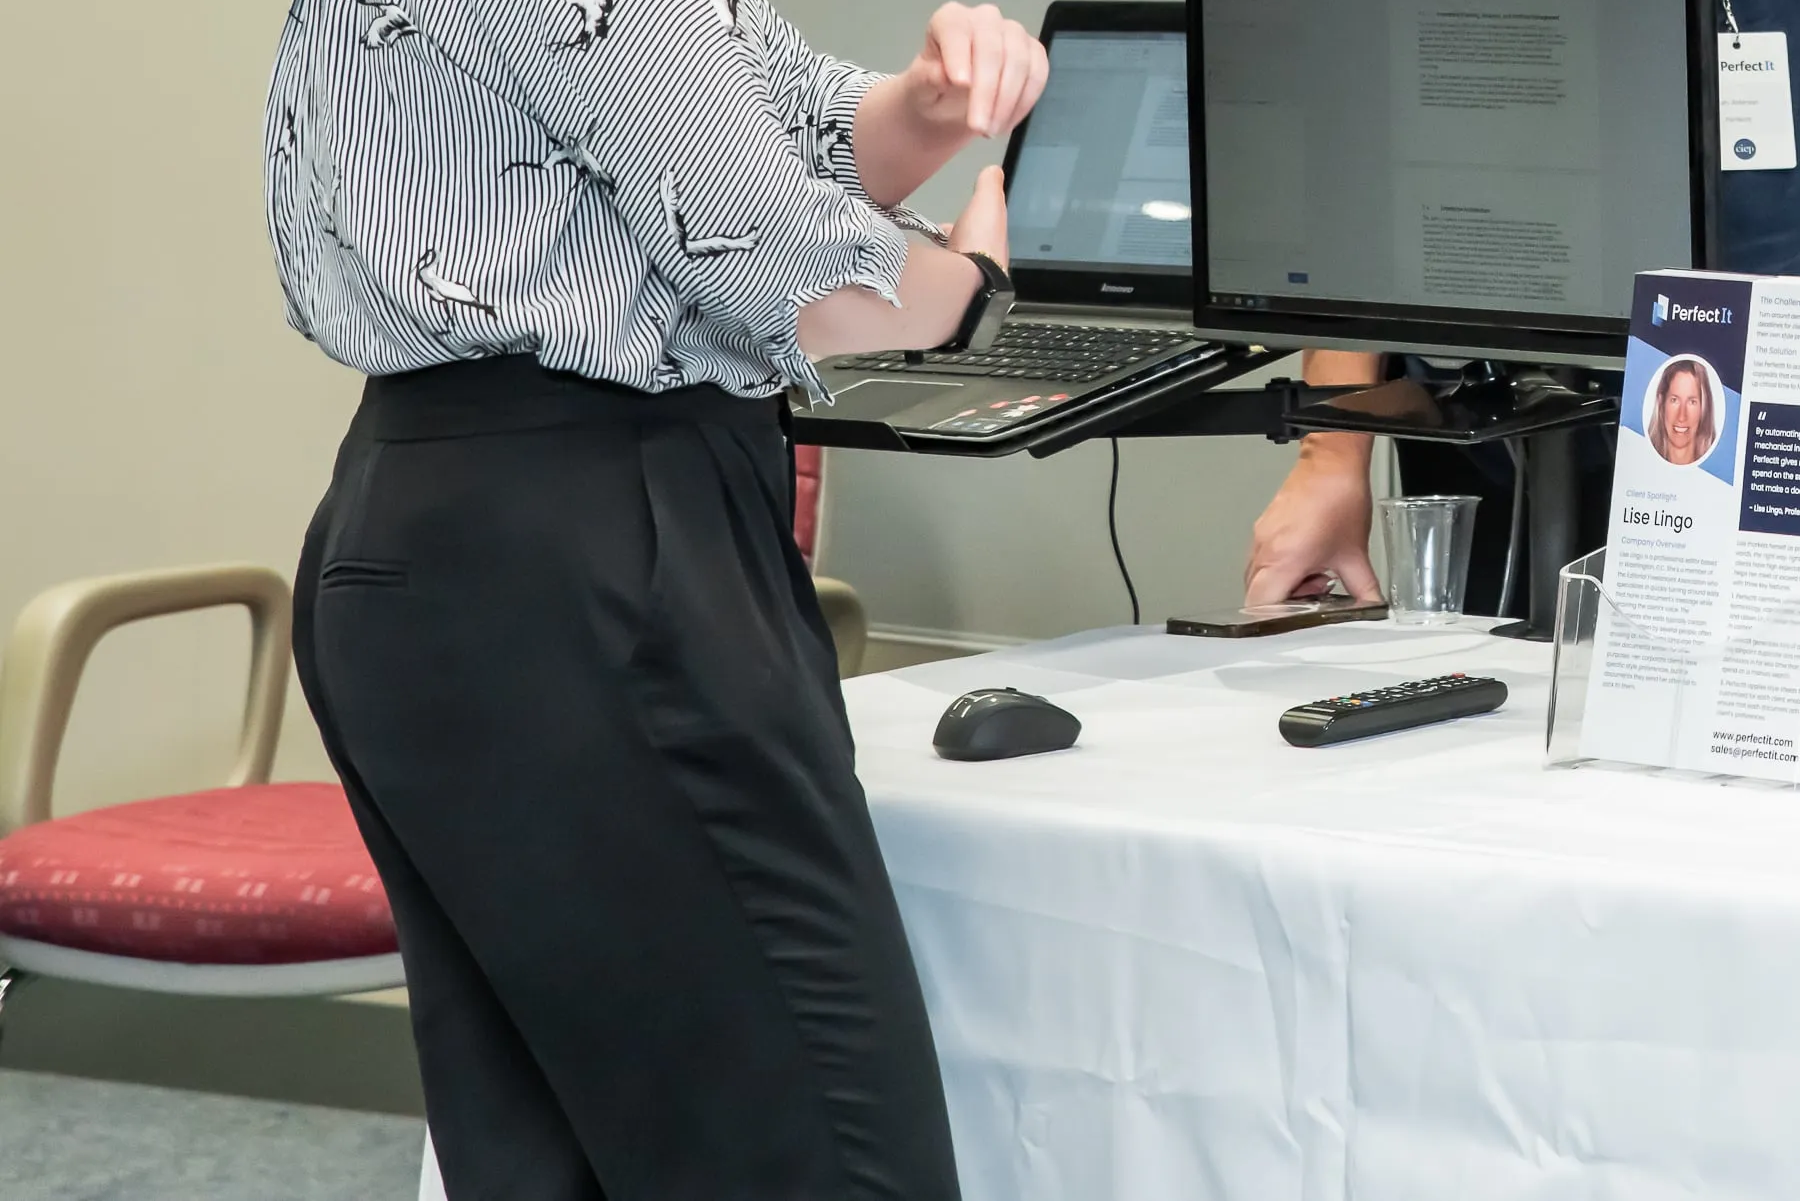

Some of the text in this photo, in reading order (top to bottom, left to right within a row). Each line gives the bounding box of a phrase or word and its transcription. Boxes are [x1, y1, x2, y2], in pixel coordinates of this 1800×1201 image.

[1721, 61, 1774, 71] PerfectIt
[1735, 144, 1754, 154] ciep
[1760, 296, 1772, 304] The
[1672, 304, 1732, 324] PerfectIt
[1769, 347, 1797, 355] Solution
[1756, 427, 1764, 436] By
[1755, 442, 1793, 451] mechanical
[1781, 458, 1797, 467] gives
[1752, 470, 1772, 479] spend
[1783, 472, 1794, 480] the
[1751, 483, 1764, 491] that
[1765, 484, 1783, 493] make
[1754, 504, 1765, 512] Lise
[1624, 507, 1693, 533] Lise Lingo
[1622, 536, 1686, 549] Company Overview
[1713, 731, 1793, 748] www.perfectit.com
[1711, 744, 1798, 762] sales@perfectit.com
